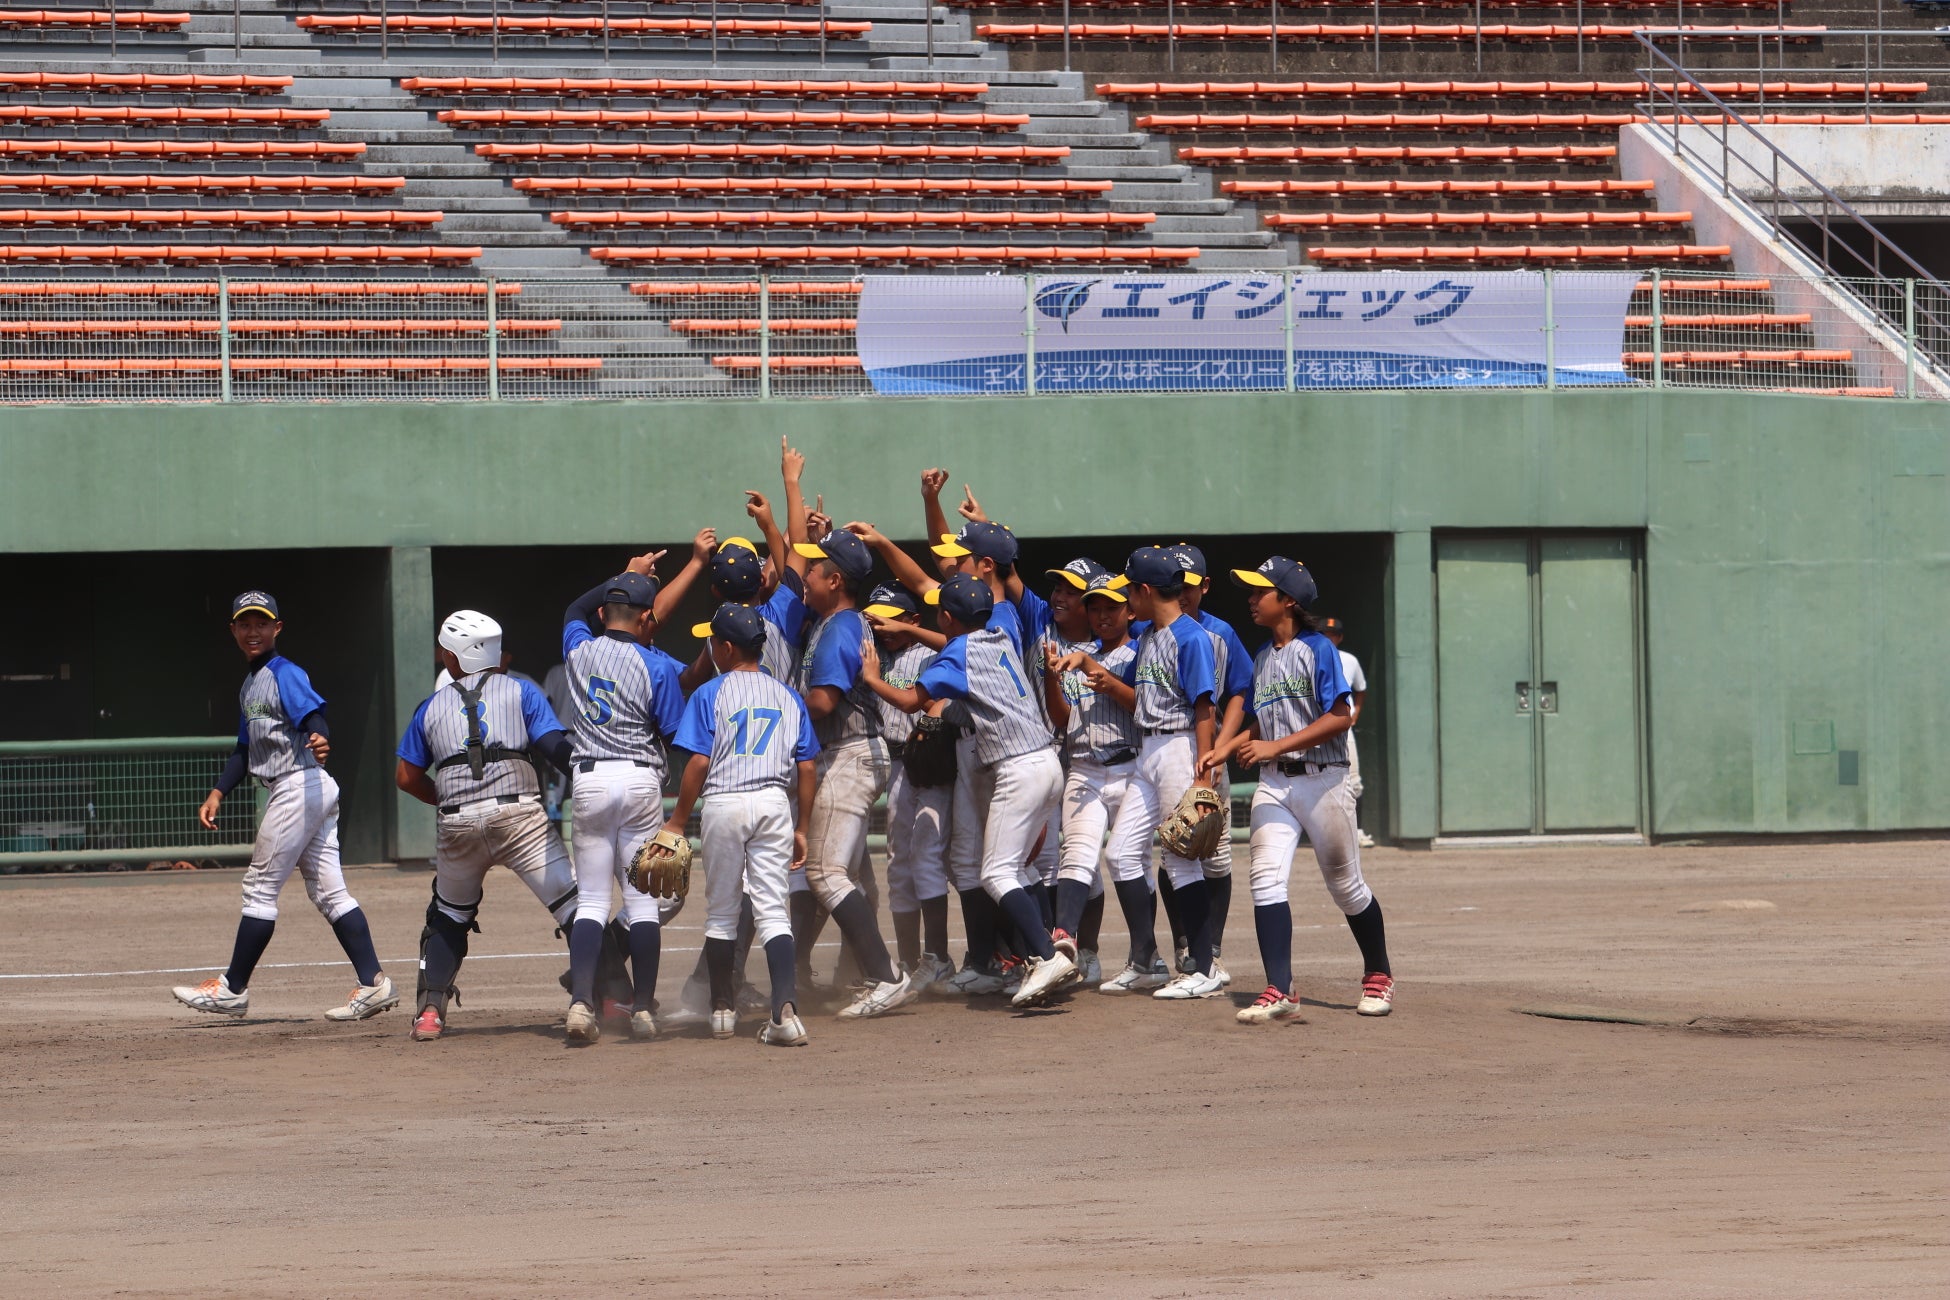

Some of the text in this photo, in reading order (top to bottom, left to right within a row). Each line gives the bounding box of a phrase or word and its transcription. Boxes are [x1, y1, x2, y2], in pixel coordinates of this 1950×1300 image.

[1101, 279, 1475, 327] エイジェック
[998, 650, 1027, 699] 1
[583, 674, 619, 727] 5
[727, 705, 784, 757] 17
